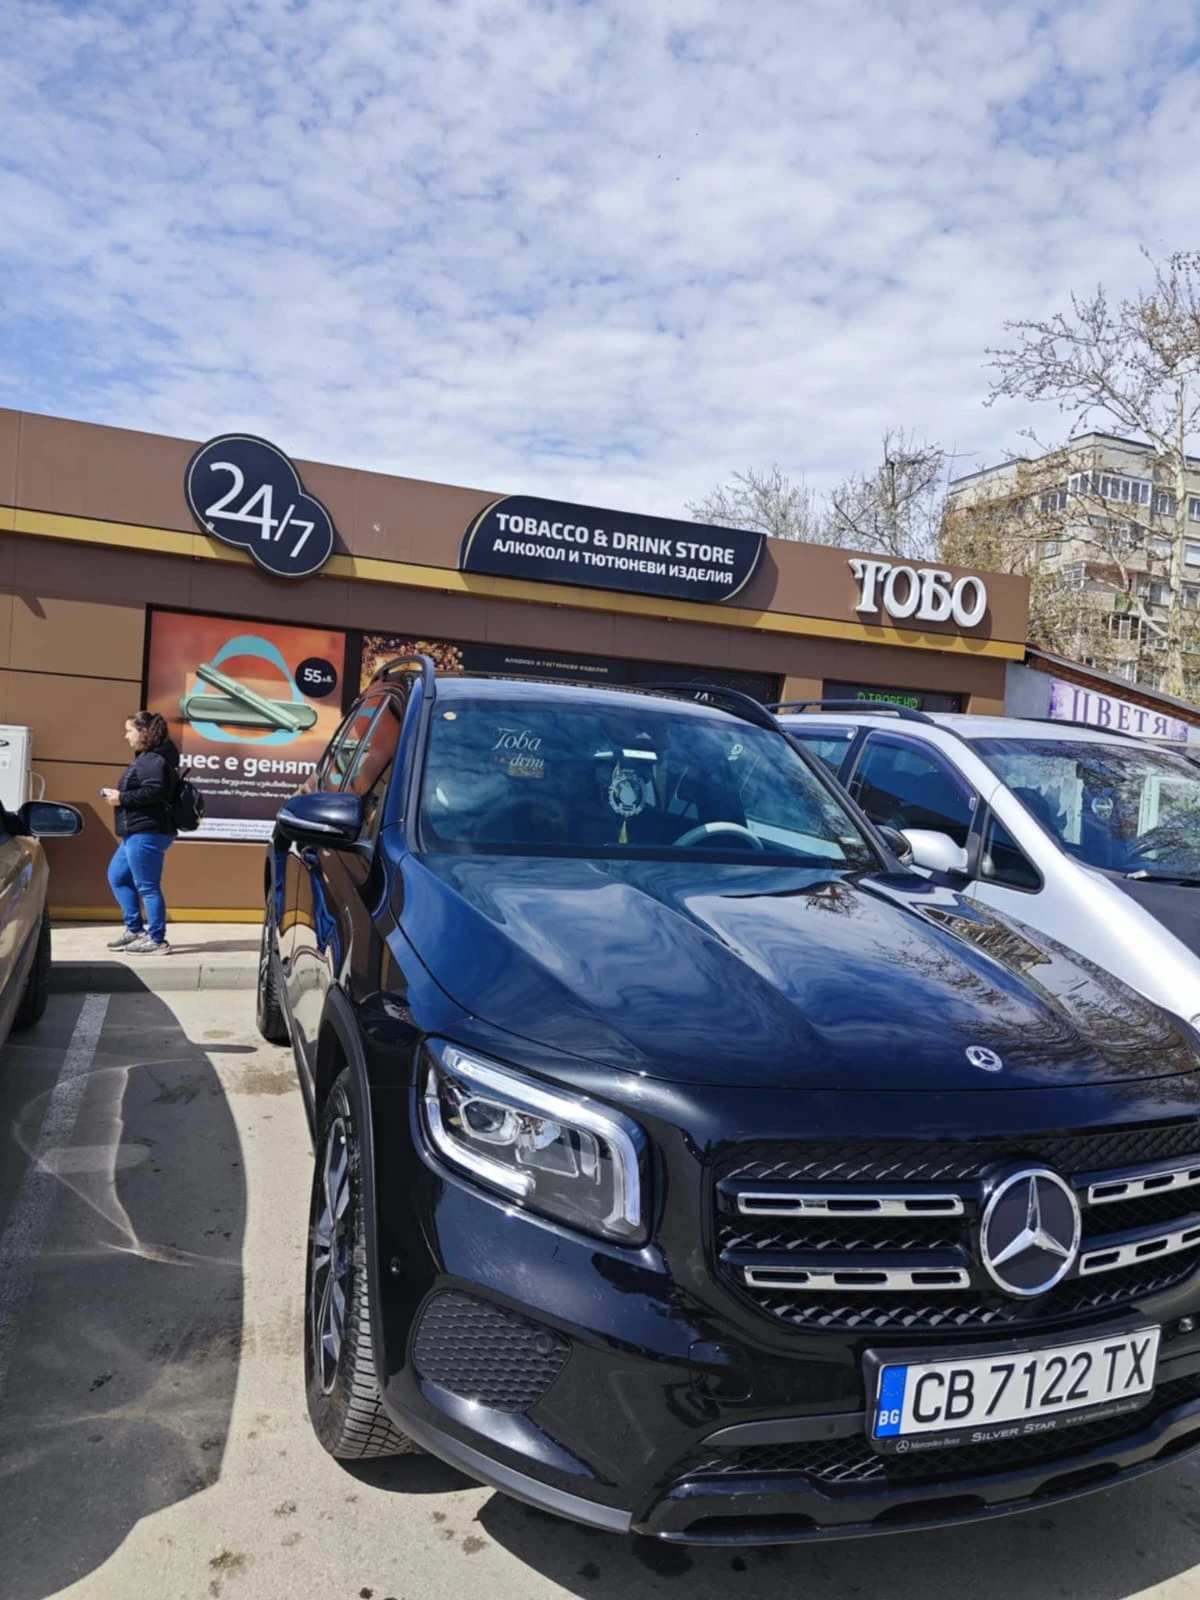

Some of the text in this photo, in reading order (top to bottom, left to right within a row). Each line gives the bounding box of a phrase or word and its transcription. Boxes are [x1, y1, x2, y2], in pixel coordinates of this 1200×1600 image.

[205, 461, 315, 558] 24/7
[493, 539, 733, 584] АЛКОХОЛ И ТЮТЮНЕВИ ИЗДЕЛИЯ
[496, 513, 735, 565] TOBACCO & DRINK STORE
[848, 558, 987, 627] ТОБО
[304, 668, 321, 683] 55
[1072, 688, 1168, 736] ЦВЕТЯ
[179, 754, 220, 769] нес
[224, 756, 239, 770] е
[879, 1338, 1151, 1426] BG CB 7122 TX
